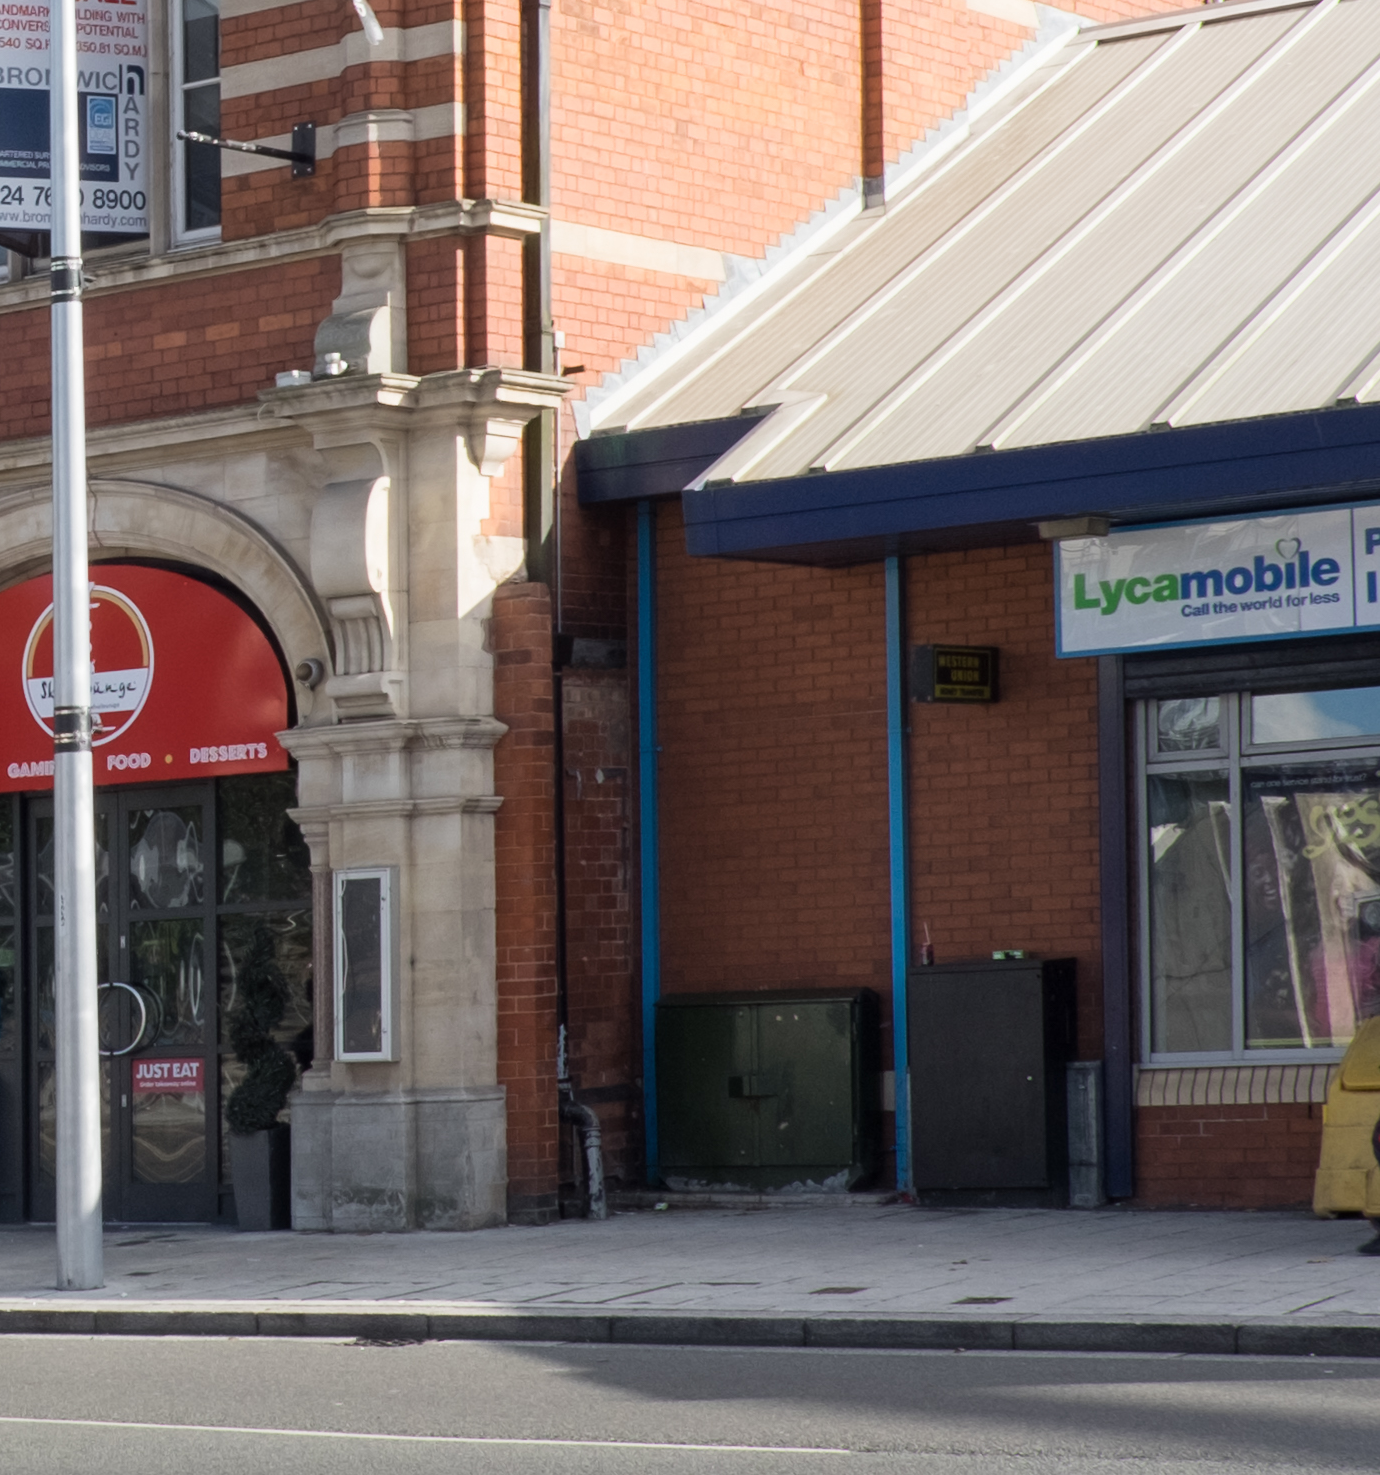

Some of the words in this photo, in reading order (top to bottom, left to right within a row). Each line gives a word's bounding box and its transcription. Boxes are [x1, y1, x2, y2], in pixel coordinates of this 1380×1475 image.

[117, 11, 146, 24] WITH
[77, 25, 139, 40] POTENTIAL
[92, 188, 147, 211] 8900
[1074, 550, 1340, 616] Lycamobile
[1181, 602, 1210, 617] Call
[1212, 599, 1237, 614] the
[1240, 595, 1282, 612] world
[1286, 593, 1308, 608] for
[1309, 590, 1340, 606] less
[106, 752, 151, 771] FOOD
[189, 743, 268, 764] DESSERTS
[136, 1063, 170, 1079] JUST
[172, 1062, 200, 1078] EAT
